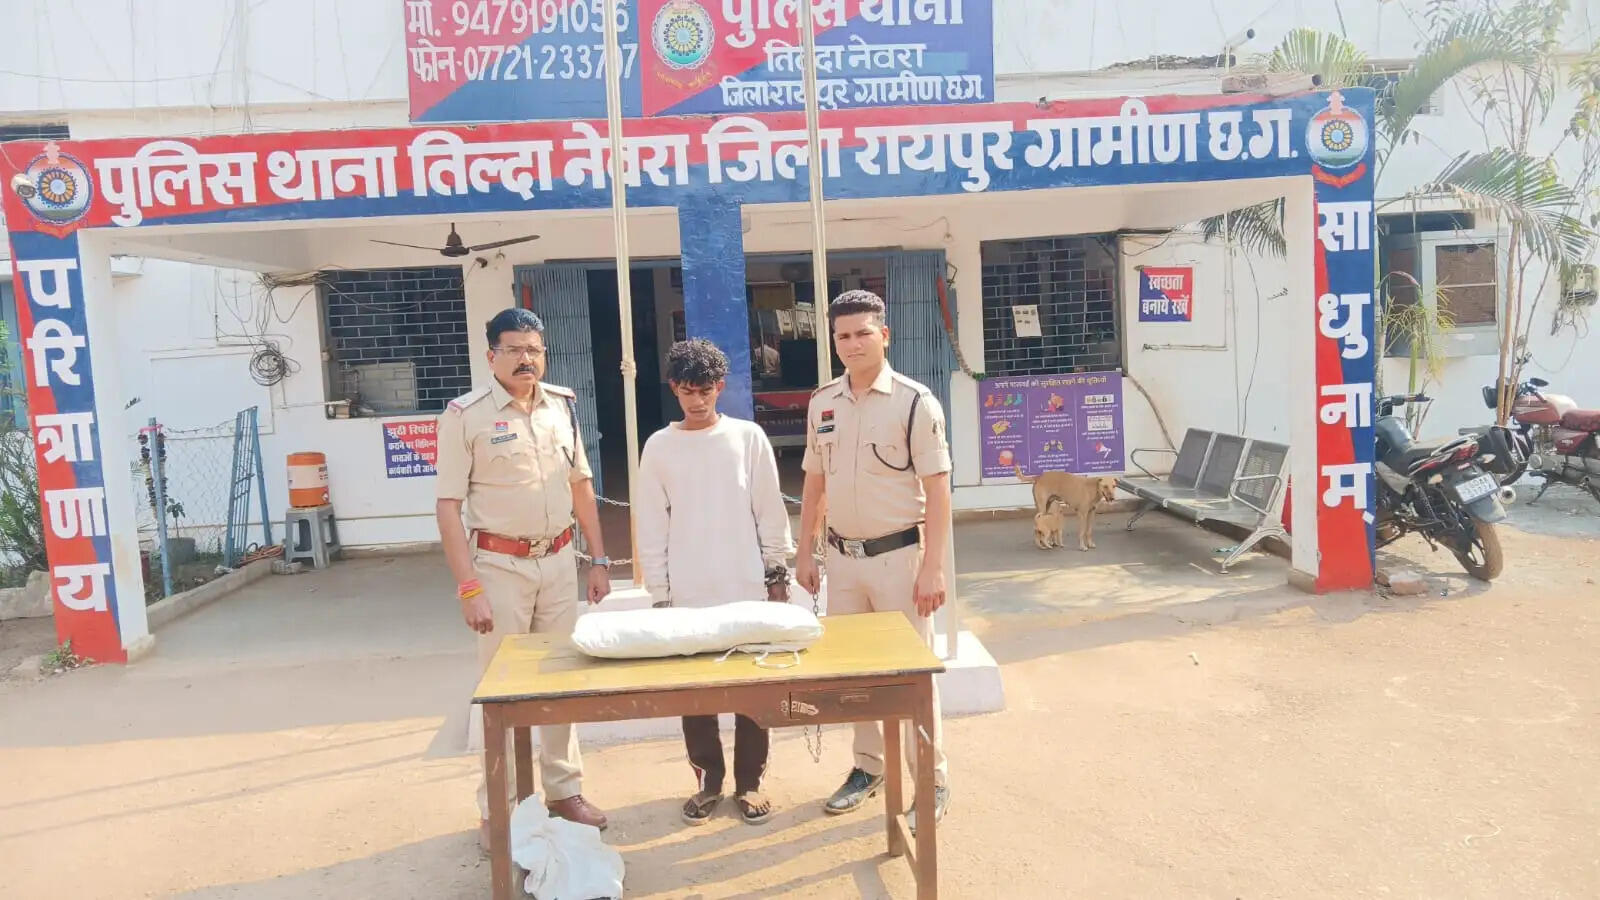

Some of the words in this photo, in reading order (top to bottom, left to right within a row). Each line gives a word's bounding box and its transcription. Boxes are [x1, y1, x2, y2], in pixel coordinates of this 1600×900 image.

[848, 34, 927, 70] नेवरा
[852, 70, 943, 104] ग्रामीण
[94, 140, 258, 227] पुलिस
[266, 146, 397, 200] थाना
[407, 130, 553, 201] तिल्दा
[563, 122, 690, 189] नेवरा
[702, 116, 843, 184] जिला
[854, 121, 1014, 192] रायपुर
[1025, 97, 1200, 171] ग्रामीण
[1148, 274, 1185, 290] स्वच्छता
